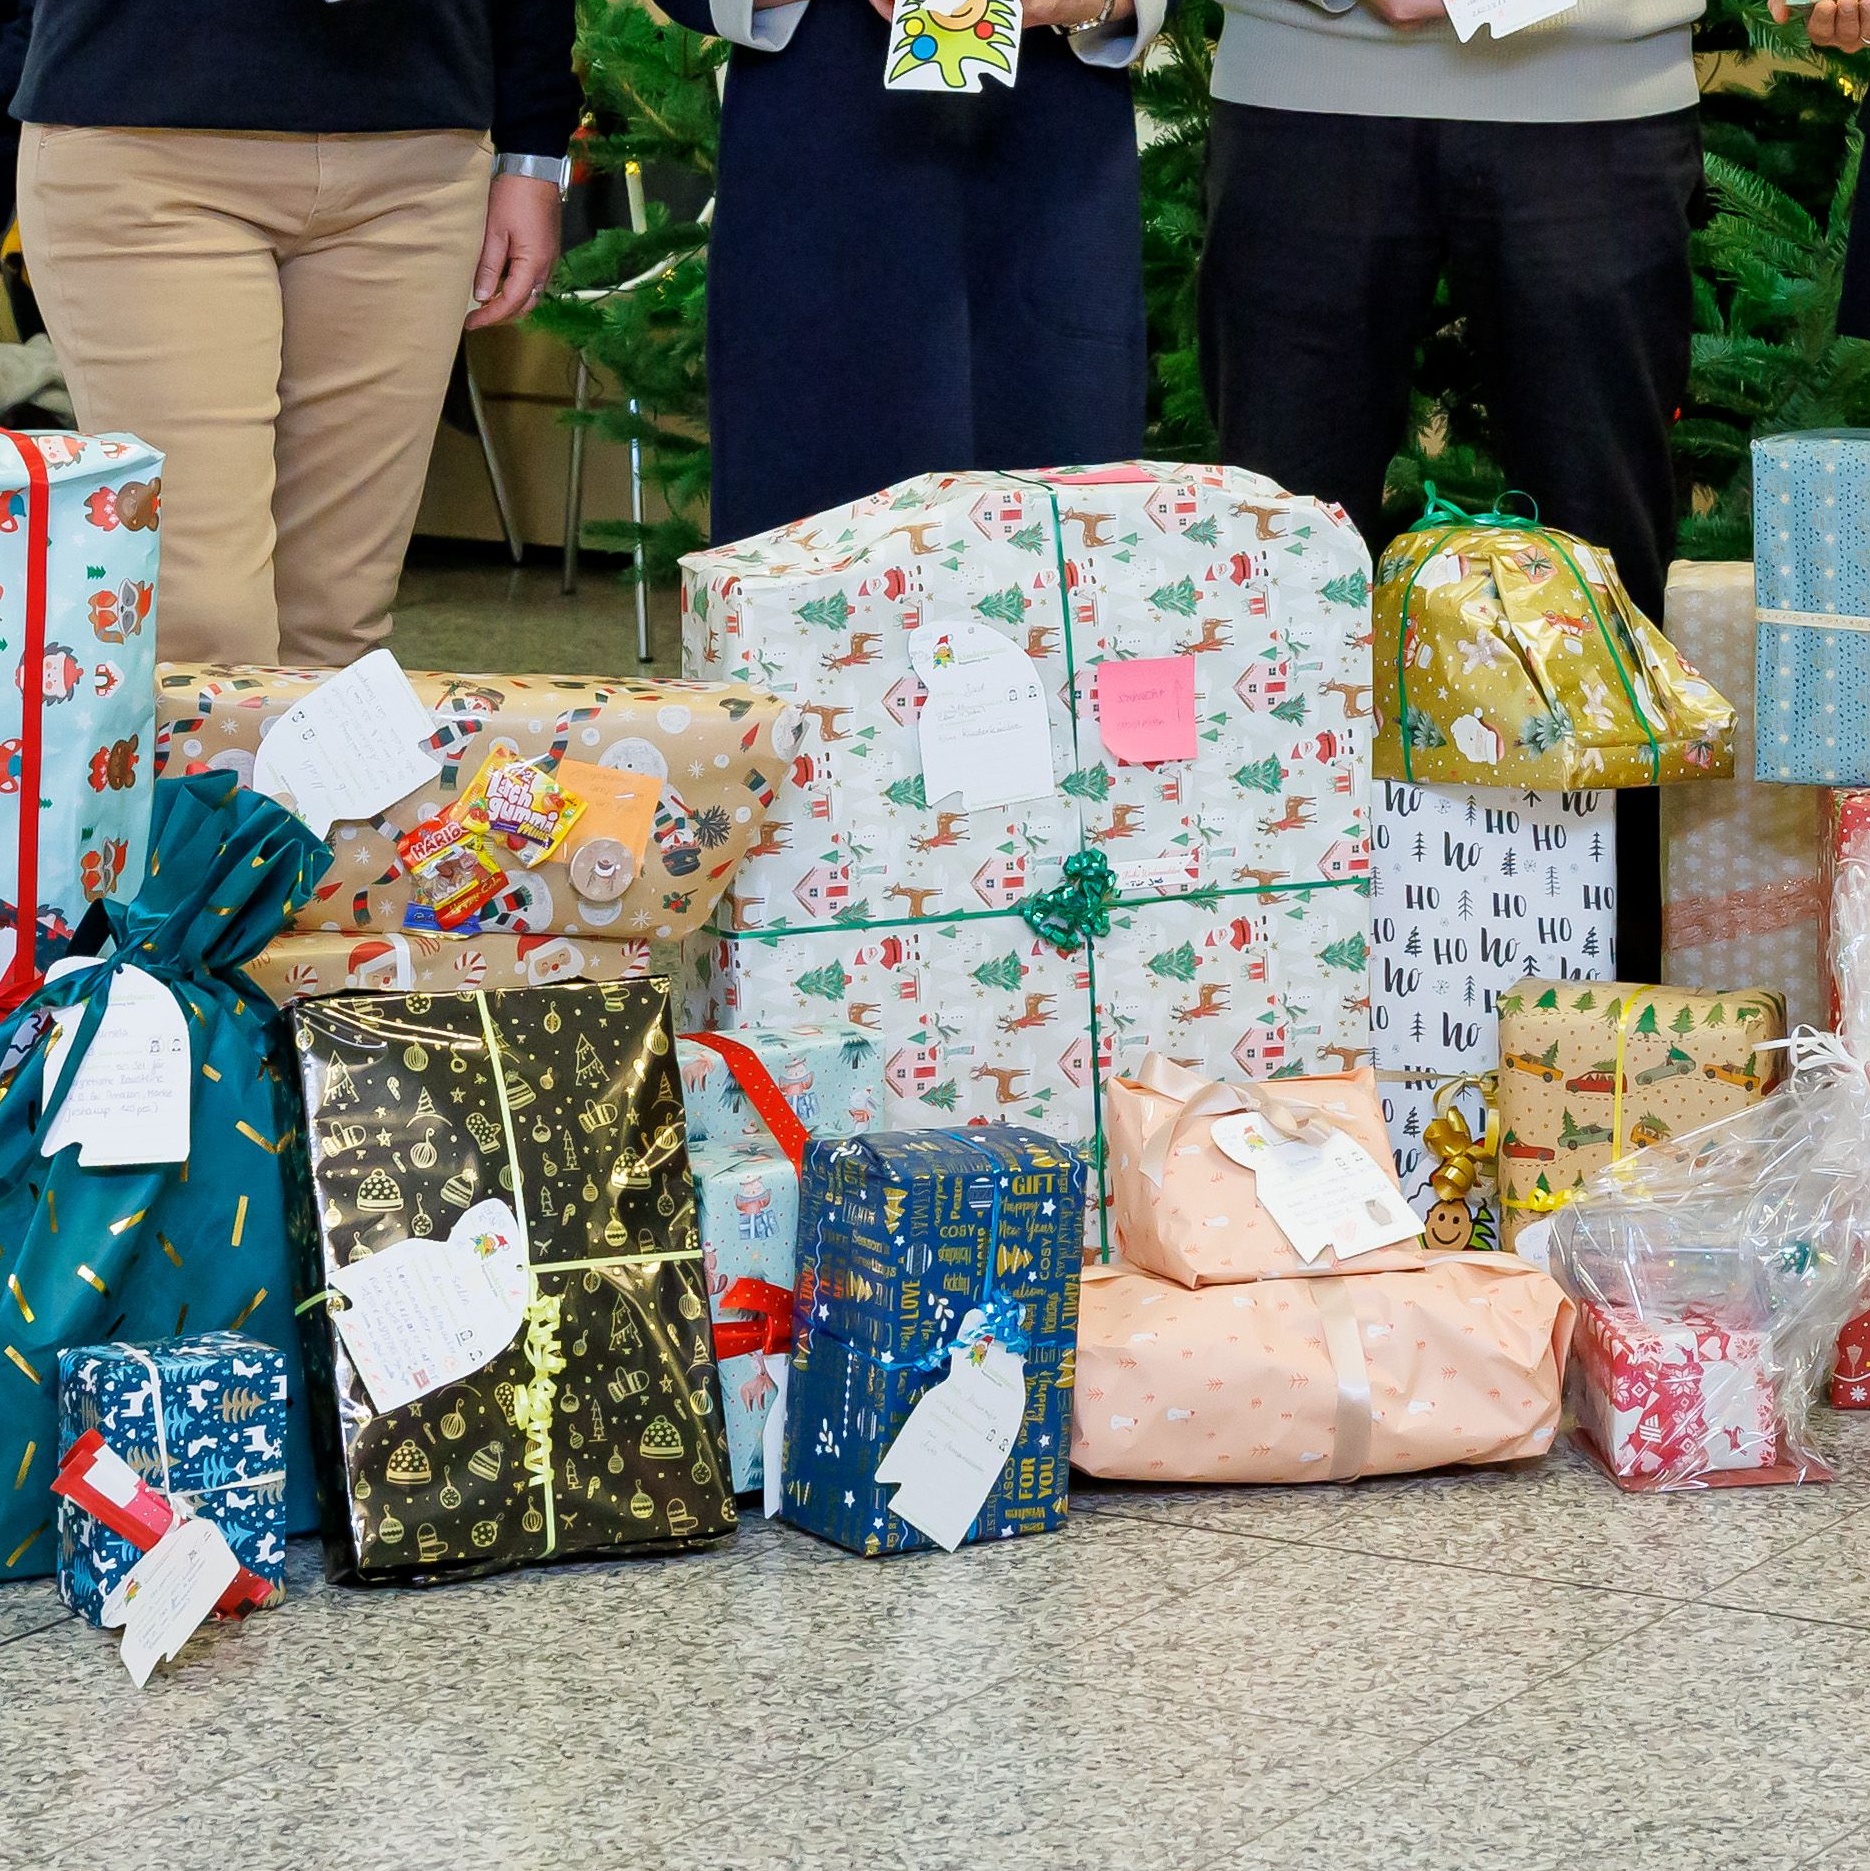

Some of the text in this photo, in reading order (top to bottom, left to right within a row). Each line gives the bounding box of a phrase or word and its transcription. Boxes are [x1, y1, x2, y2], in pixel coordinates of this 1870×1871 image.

[1486, 807, 1519, 834] HO
[1533, 823, 1566, 852] HO
[1443, 831, 1482, 872] ho
[1405, 883, 1440, 910] HO
[1493, 892, 1527, 919] HO
[1583, 883, 1615, 910] HO
[1538, 916, 1572, 944] HO
[1434, 937, 1468, 965] HO
[1481, 927, 1520, 968] ho
[1384, 957, 1422, 997] ho
[1442, 1011, 1482, 1052] ho
[1012, 1174, 1057, 1195] GIFT
[1000, 1196, 1040, 1217] Happy
[940, 1224, 976, 1238] COSY
[1039, 1238, 1052, 1282] COSY
[900, 1279, 921, 1320] LOVE
[1061, 1273, 1079, 1330] FAMILY
[1003, 1456, 1016, 1501] COSY
[1018, 1457, 1036, 1501] FOR
[1037, 1456, 1055, 1500] YOU
